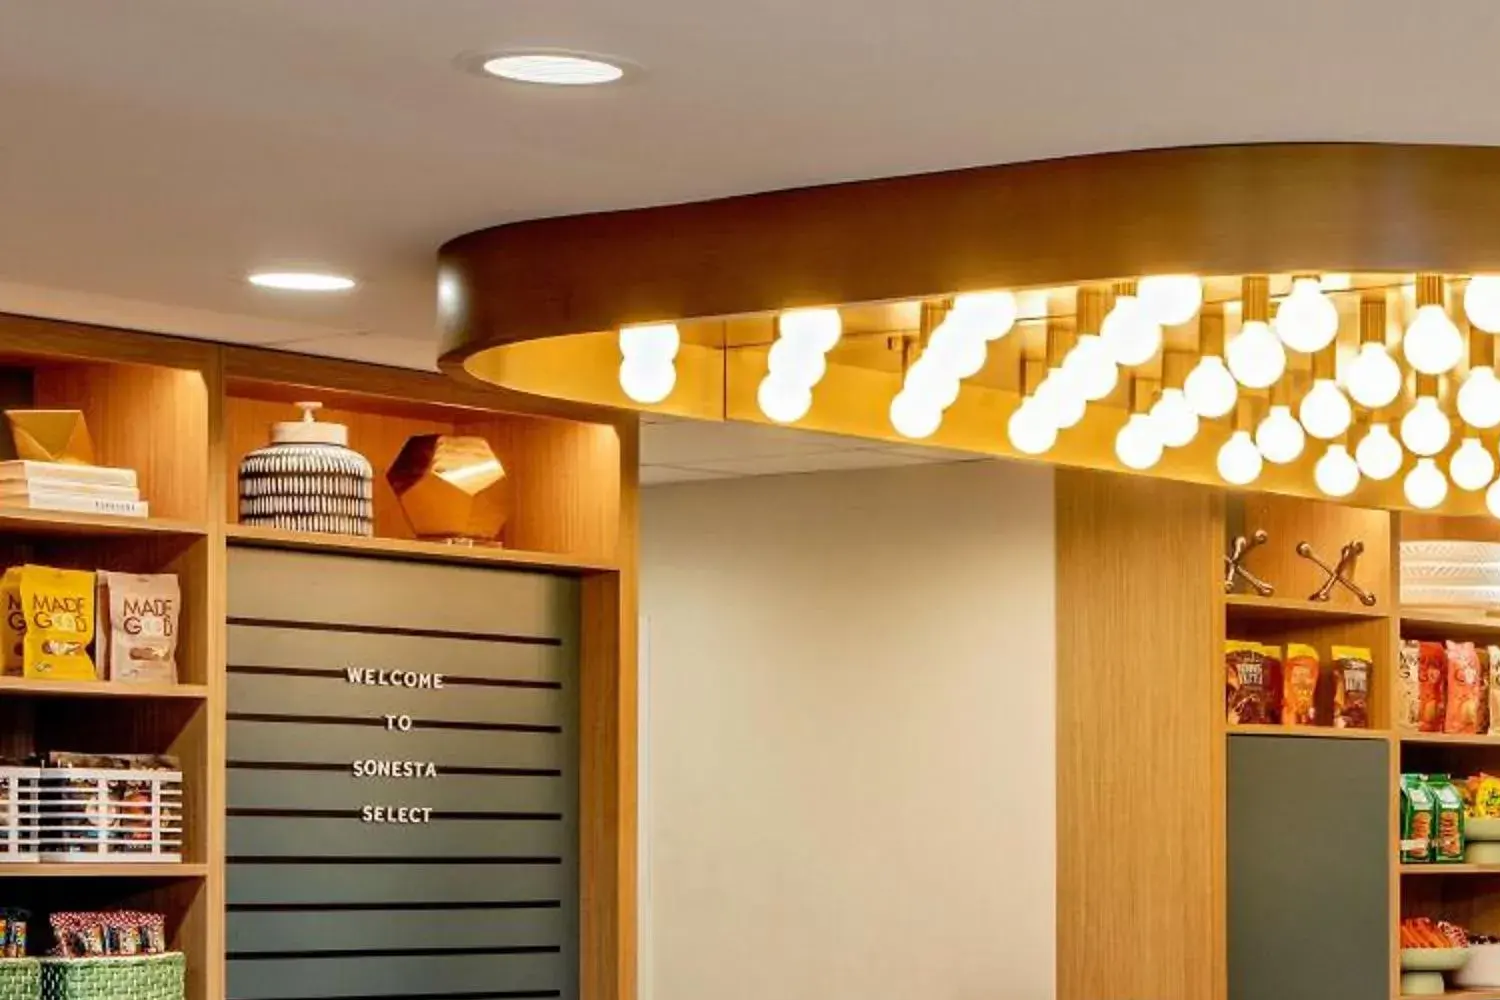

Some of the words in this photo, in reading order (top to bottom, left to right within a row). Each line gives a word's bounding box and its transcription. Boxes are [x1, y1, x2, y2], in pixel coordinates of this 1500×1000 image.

[347, 667, 444, 689] WELCOME
[385, 714, 413, 731] TO
[353, 759, 437, 778] SONESTA
[362, 805, 433, 823] SELECT
